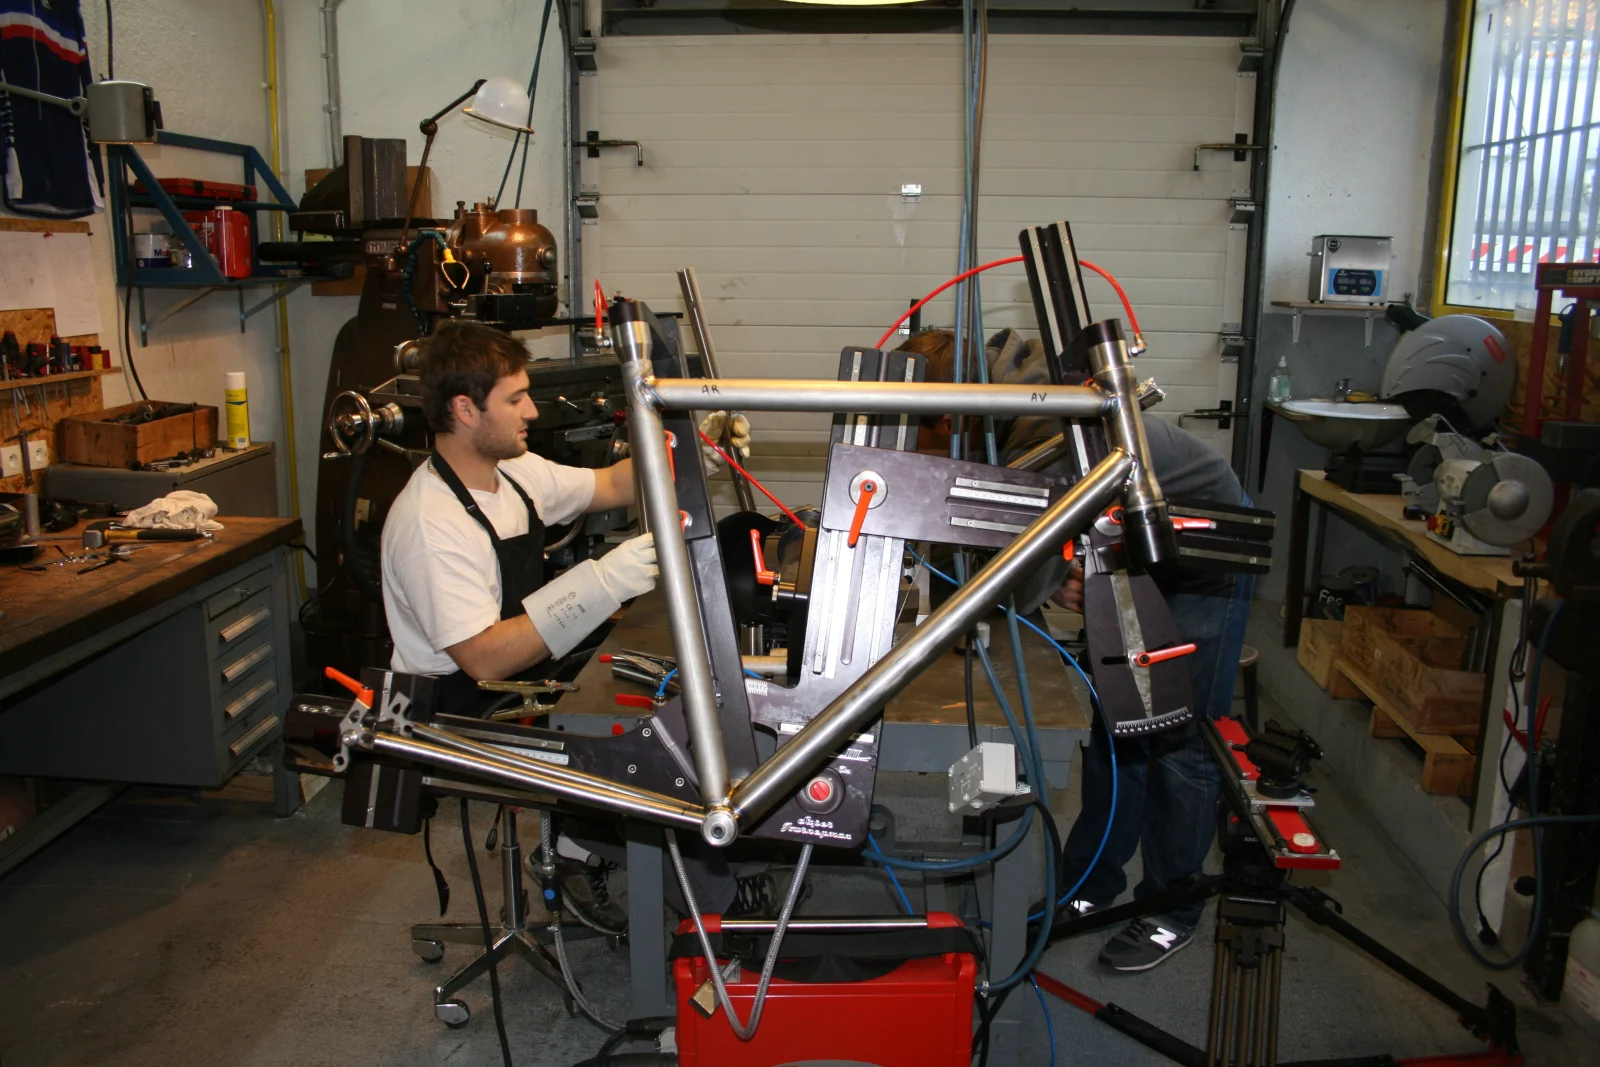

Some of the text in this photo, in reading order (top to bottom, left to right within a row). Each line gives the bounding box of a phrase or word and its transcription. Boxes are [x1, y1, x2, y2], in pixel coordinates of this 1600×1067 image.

[701, 384, 721, 395] AR
[1030, 392, 1048, 403] AV
[1150, 926, 1177, 949] N
